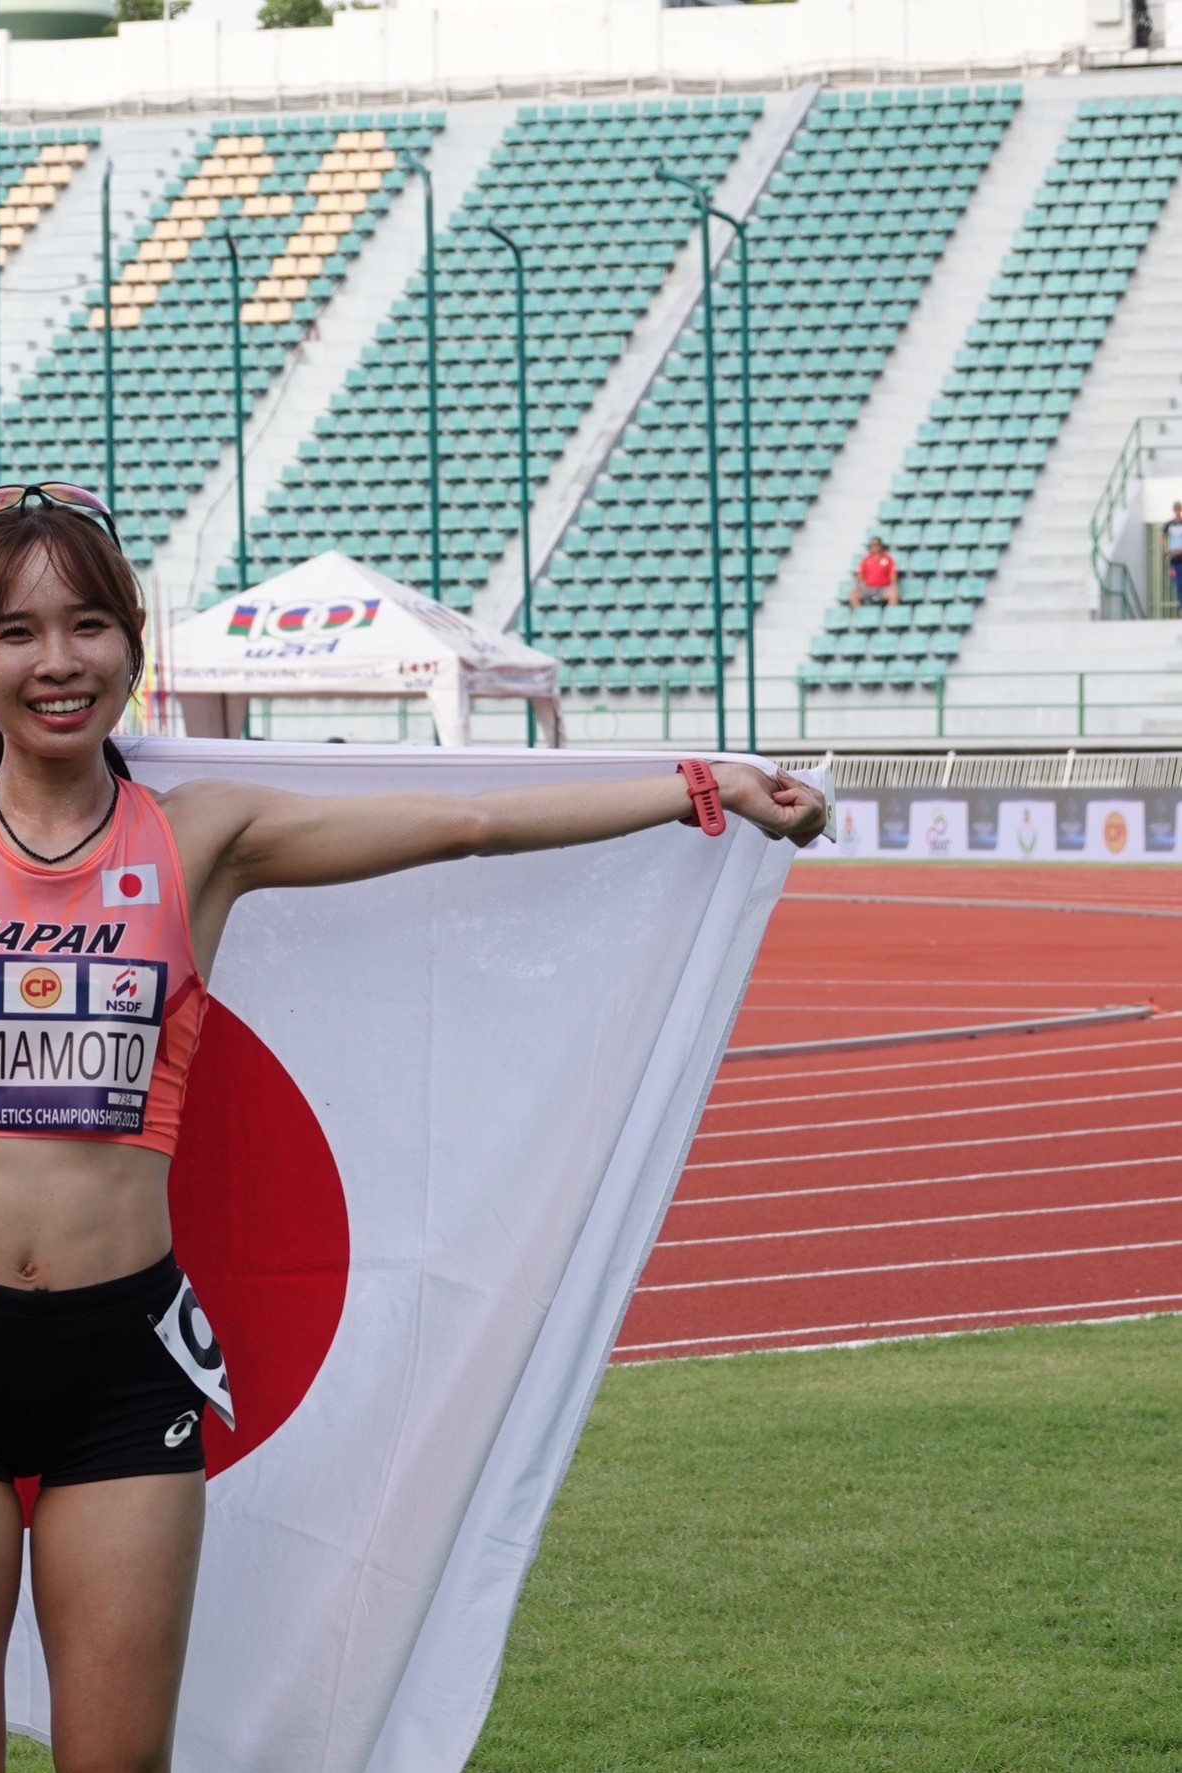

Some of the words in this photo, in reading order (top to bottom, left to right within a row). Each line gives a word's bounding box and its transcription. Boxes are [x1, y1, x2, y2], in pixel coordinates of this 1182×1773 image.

[24, 978, 57, 997] CP
[105, 1000, 143, 1013] NSDF
[35, 1108, 122, 1127] CHAMPIONSHIPS
[122, 1111, 140, 1128] 2023
